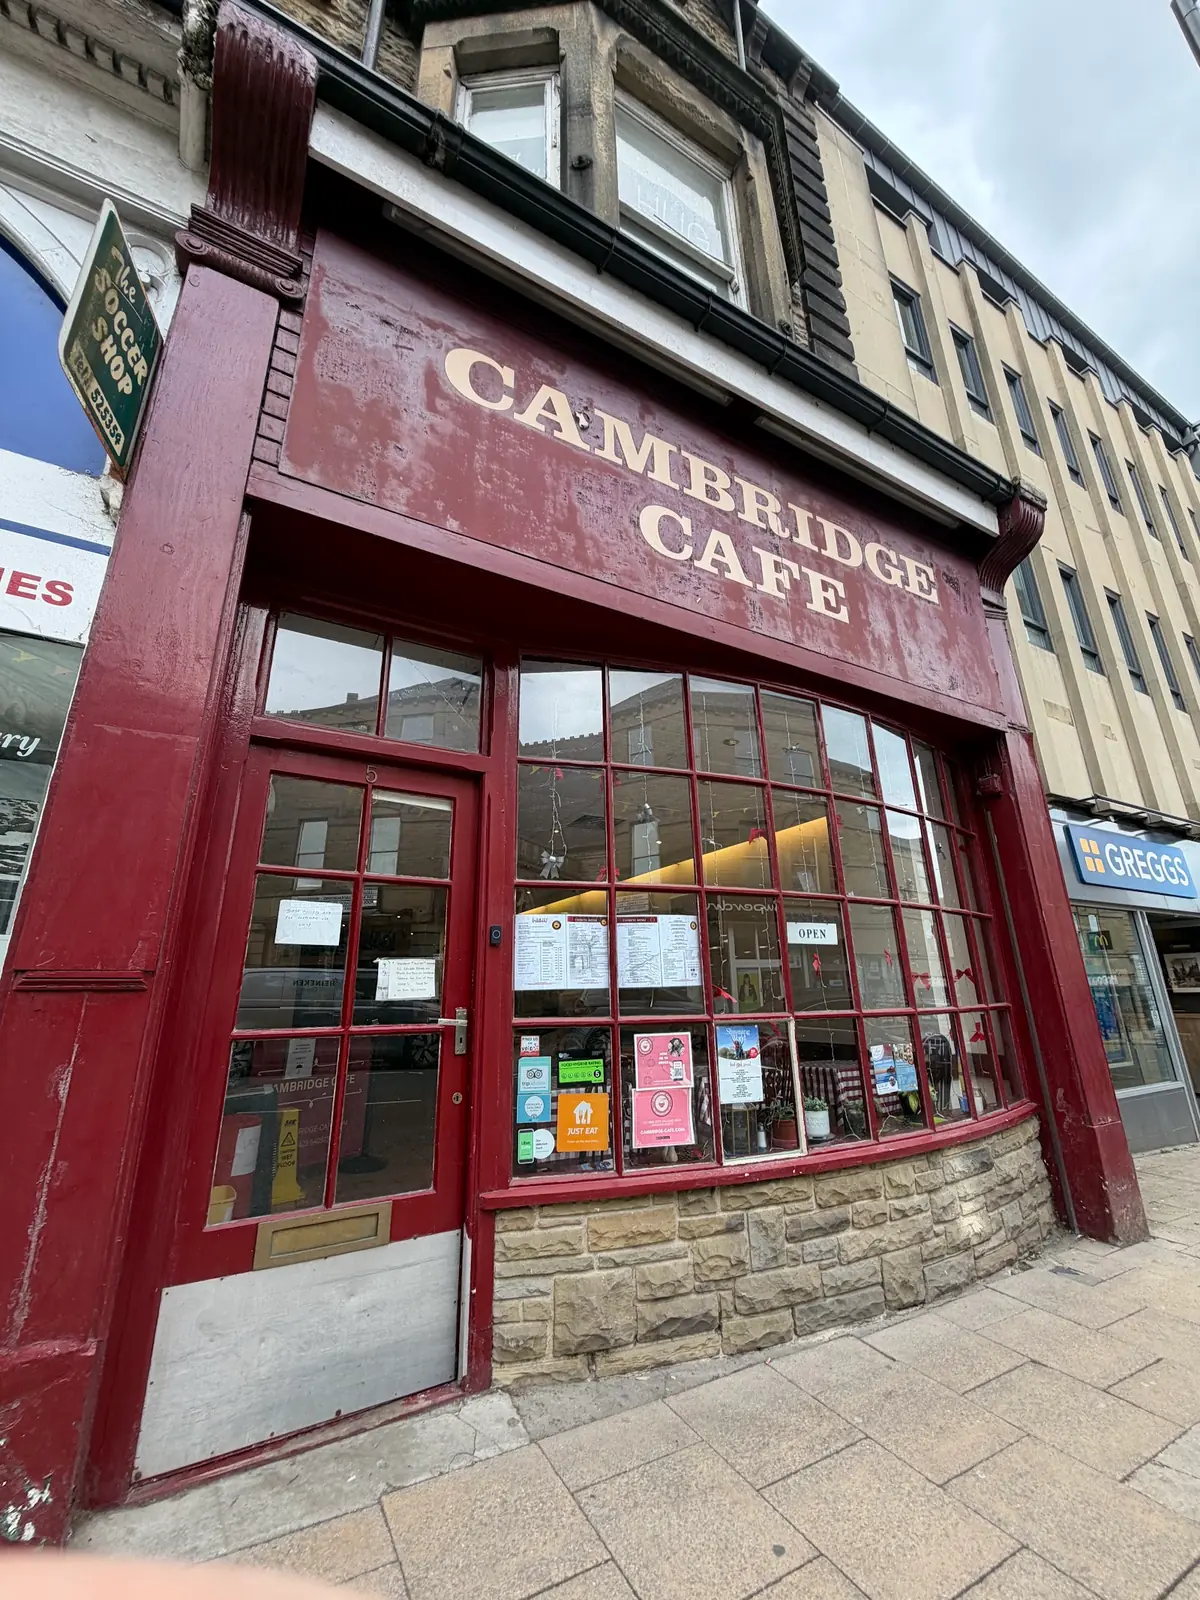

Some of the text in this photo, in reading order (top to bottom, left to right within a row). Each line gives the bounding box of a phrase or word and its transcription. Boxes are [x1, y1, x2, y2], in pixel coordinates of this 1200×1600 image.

[111, 245, 136, 304] The
[95, 267, 148, 386] SOCCER
[92, 316, 133, 395] SHOP
[444, 347, 940, 606] CAMBRIDGE
[639, 503, 850, 625] CAFE
[0, 732, 41, 757] ry
[364, 764, 378, 784] 5
[1104, 842, 1189, 887] GREGGS
[798, 928, 827, 940] OPEN
[274, 1077, 329, 1093] AMBRIDGE
[567, 1127, 599, 1136] JUST EAT
